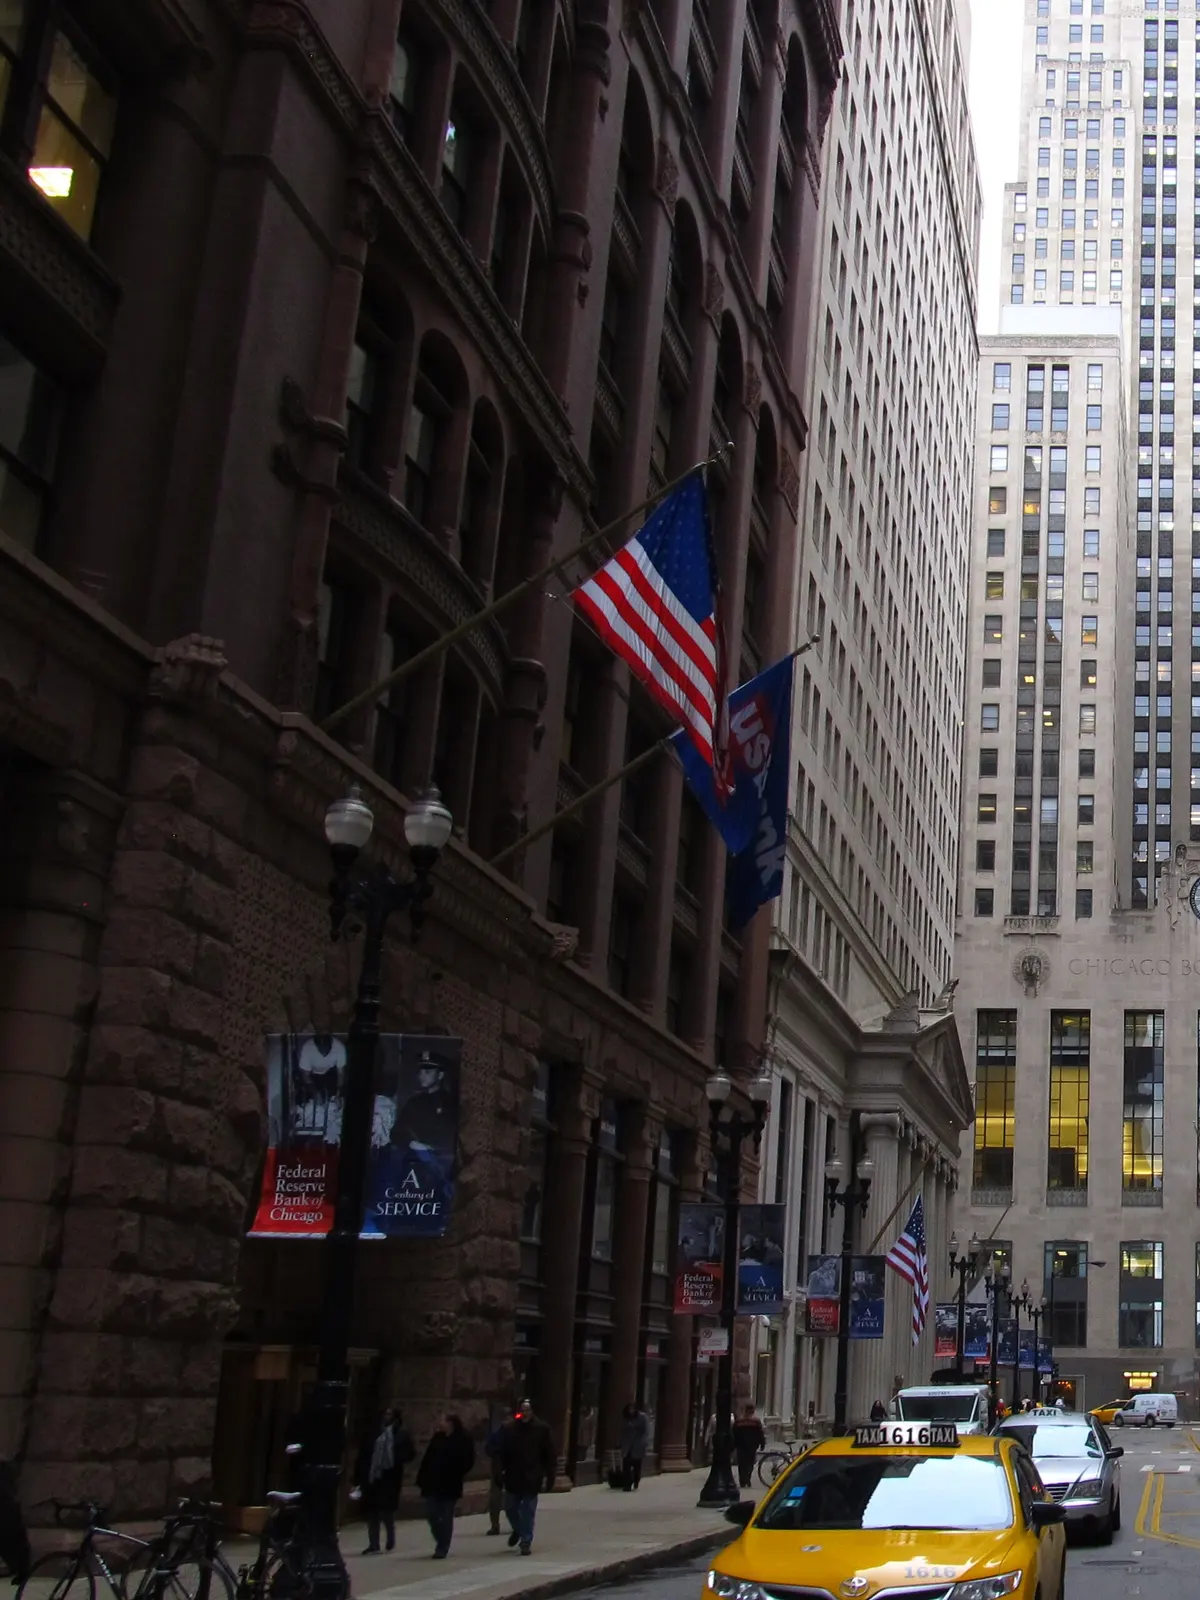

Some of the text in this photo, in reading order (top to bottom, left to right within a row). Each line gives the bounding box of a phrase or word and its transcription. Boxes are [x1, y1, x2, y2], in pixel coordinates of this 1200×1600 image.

[1068, 958, 1172, 976] CHICAGO
[276, 1164, 326, 1178] Federal
[276, 1178, 325, 1193] Reserve
[401, 1168, 420, 1189] A
[273, 1193, 326, 1209] Bank of
[384, 1187, 424, 1201] Century
[269, 1207, 324, 1224] Chicago
[376, 1201, 442, 1217] SERVICE
[683, 1273, 714, 1282] Federal
[756, 1275, 766, 1287] A
[683, 1281, 714, 1289] Reserve
[682, 1288, 705, 1297] Bank
[682, 1297, 714, 1307] Chicago
[864, 1308, 872, 1317] A
[1032, 1408, 1057, 1417] TAXI
[856, 1426, 955, 1444] TAXI 1616 TAXI
[904, 1566, 957, 1579] 1616
